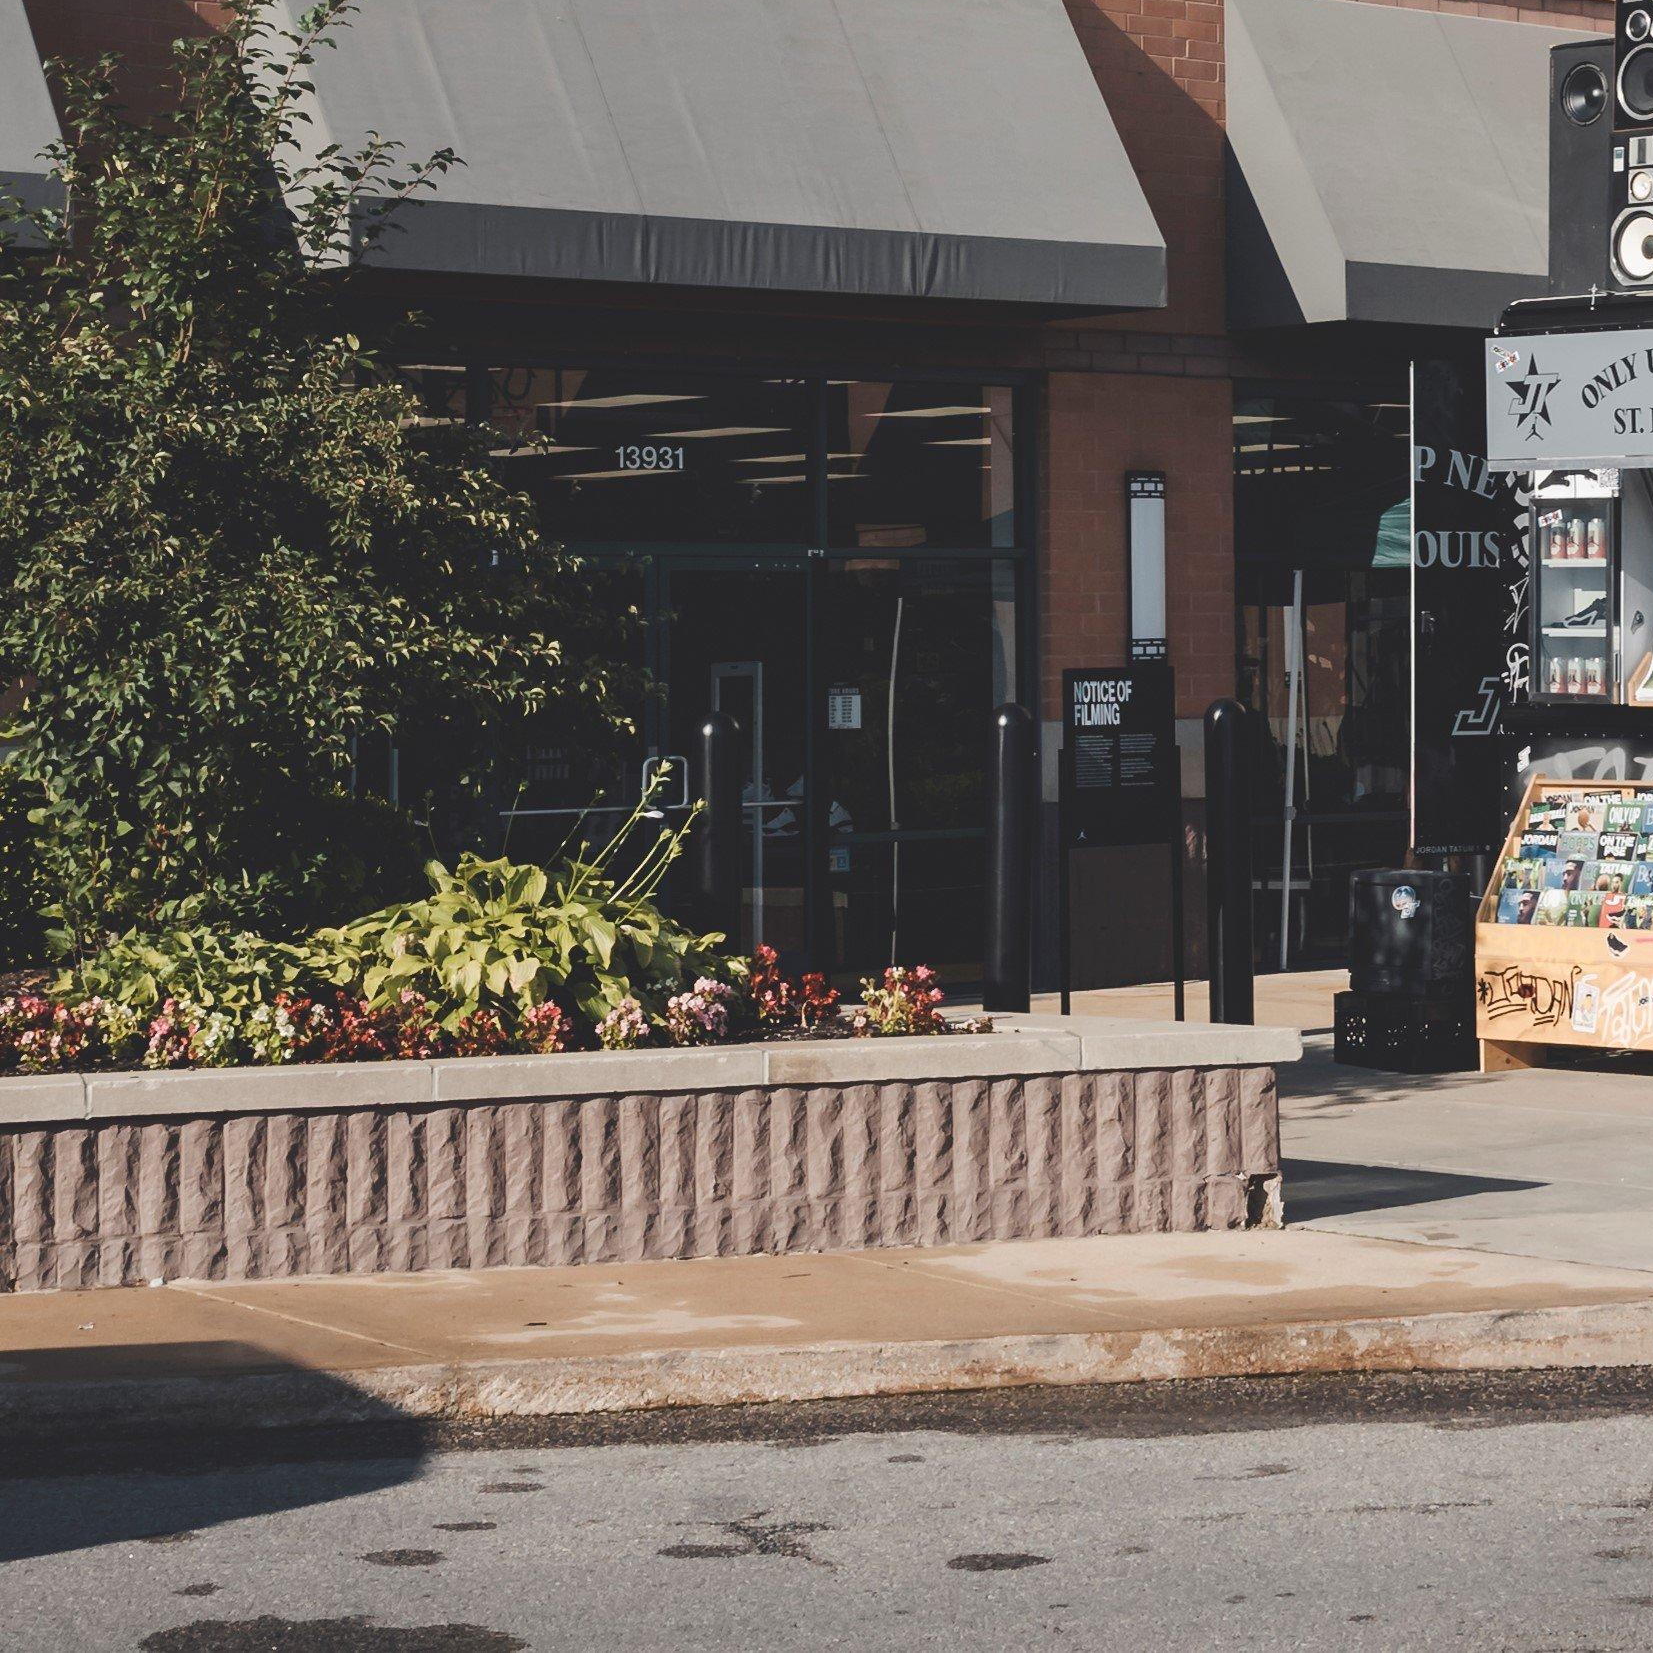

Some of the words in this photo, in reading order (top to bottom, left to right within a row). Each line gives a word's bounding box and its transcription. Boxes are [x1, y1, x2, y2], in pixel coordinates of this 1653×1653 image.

[1581, 352, 1637, 409] ONLY
[1613, 408, 1645, 434] ST.
[615, 445, 684, 469] 13931
[1414, 530, 1500, 569] OUIS
[1073, 681, 1116, 704] NOTICE
[1117, 680, 1133, 702] OF
[1074, 704, 1121, 727] FILMING
[1600, 835, 1616, 847] ON
[1616, 836, 1635, 847] THE
